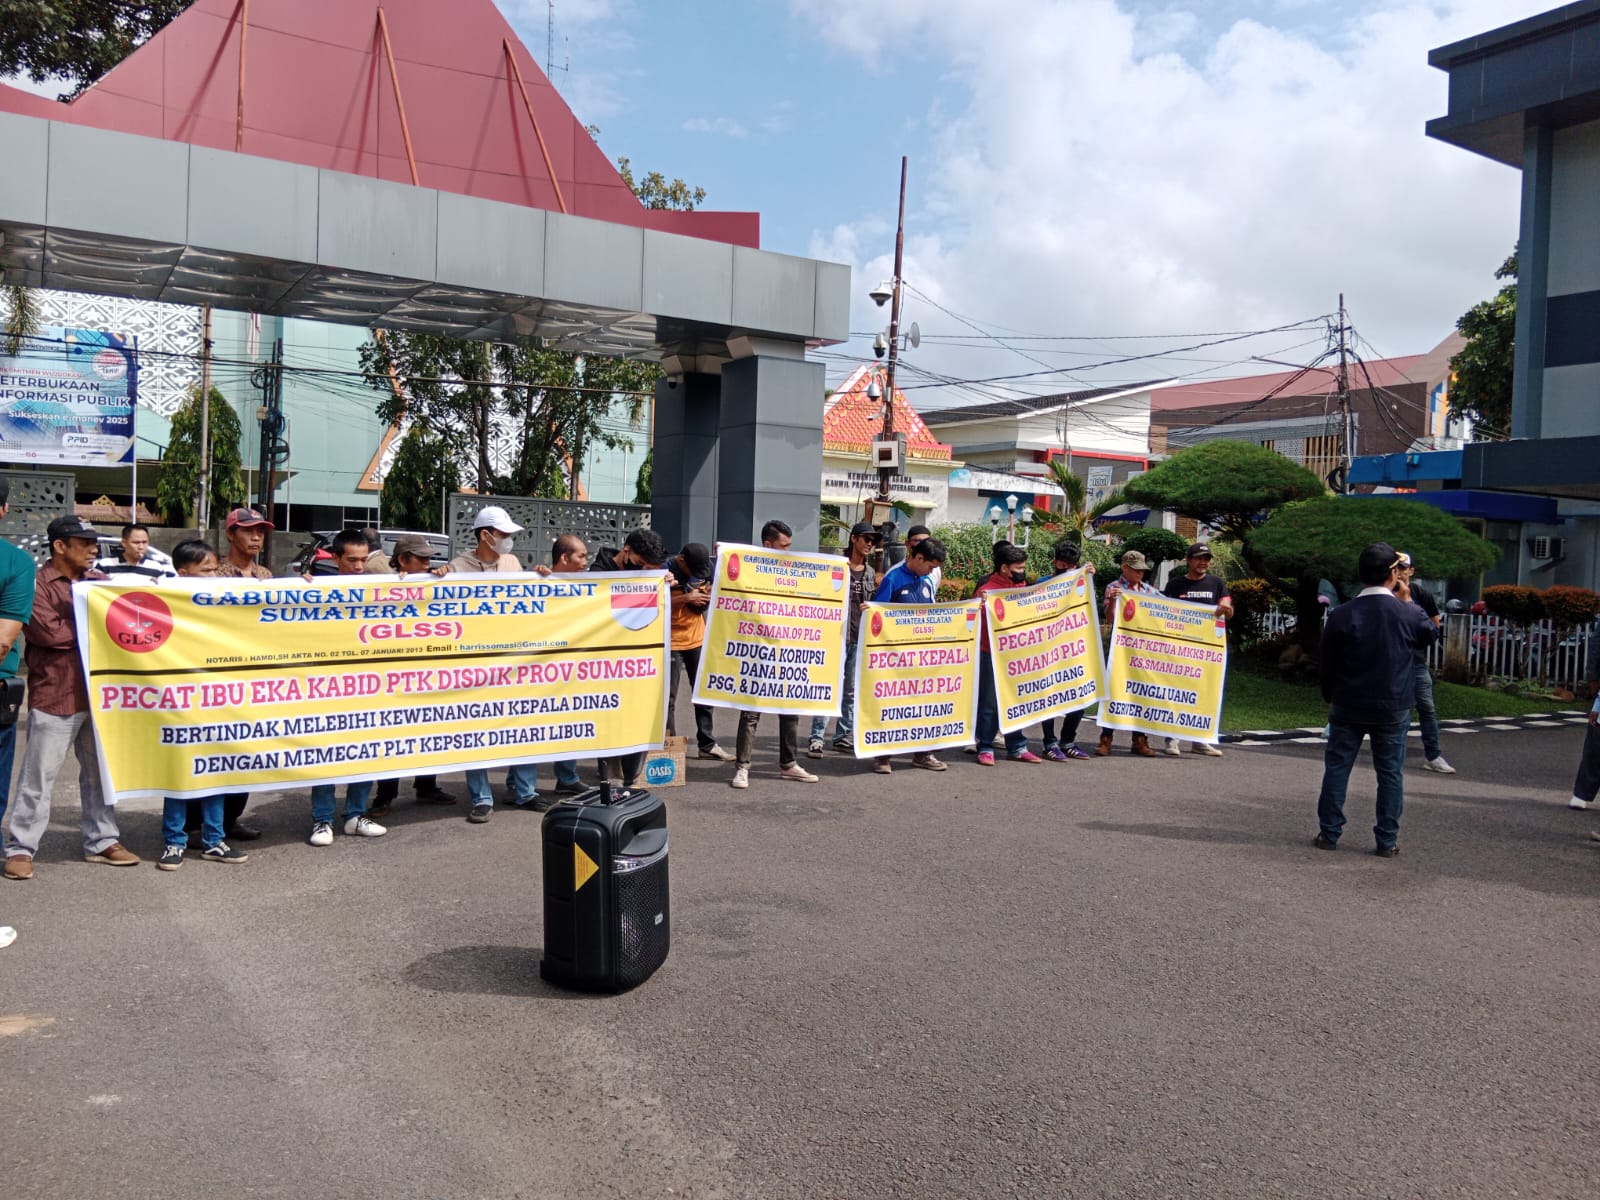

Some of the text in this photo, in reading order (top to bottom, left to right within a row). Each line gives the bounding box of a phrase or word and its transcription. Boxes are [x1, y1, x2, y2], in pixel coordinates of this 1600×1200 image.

[0, 375, 100, 392] ETERBUKAAN
[77, 394, 131, 408] PUBLIK
[8, 410, 60, 420] Sukseskan
[106, 416, 129, 425] 2025
[67, 436, 88, 444] PPID
[743, 555, 779, 565] GABUNGAN
[792, 561, 830, 572] INDEPENDENT
[756, 565, 817, 578] SUMATERA SELATAN
[191, 583, 597, 606] GABUNGAN LSM INDEPENDENT
[611, 584, 658, 593] INDONESIA
[775, 578, 798, 588] (GLSS)
[260, 600, 545, 622] SUMATERA SELATAN
[716, 597, 842, 621] PECAT KEPALA SEKOLAH
[117, 630, 162, 646] GLSS
[358, 621, 464, 644] (GLSS)
[738, 622, 822, 641] KS.SMAN.09 PLG
[913, 626, 934, 635] (GLSS)
[998, 628, 1044, 652] PECAT
[1047, 611, 1088, 640] KEPALA
[206, 655, 243, 664] NOTARIS
[371, 647, 404, 656] JANUARI
[426, 644, 453, 653] Email
[725, 641, 826, 665] DIDUGA KORUPSI
[868, 648, 970, 670] PECAT KEPALA
[1008, 639, 1086, 676] SMAN.13 PLG
[1116, 634, 1145, 650] PECAT
[1146, 639, 1177, 655] KETUA
[1178, 645, 1205, 660] MKKS
[1205, 650, 1223, 663] PLG
[740, 661, 810, 684] DANA BOOS,
[1129, 656, 1202, 679] KS.SMAN.13 PLG
[101, 657, 657, 710] PECAT IBU EKA KABID PTK DISDIK PROV SUMSEL
[707, 675, 832, 701] PSG, & DANA KOMITE
[874, 676, 962, 698] SMAN.13 PLG
[1017, 665, 1084, 696] PUNGLI UANG
[1007, 680, 1096, 720] SERVER SPMB 2025
[1125, 680, 1197, 705] PUNGLI UANG
[161, 693, 619, 744] BERTINDAK MELEBIHI KEWENANGAN KEPALA DINAS
[881, 703, 953, 721] PUNGLI UANG
[1108, 701, 1211, 730] SERVER 6JUTA /SMAN
[865, 722, 965, 745] SERVER SPMB 2025
[194, 723, 595, 775] DENGAN MEMECAT PLT KEPSEK DIHARI LIBUR
